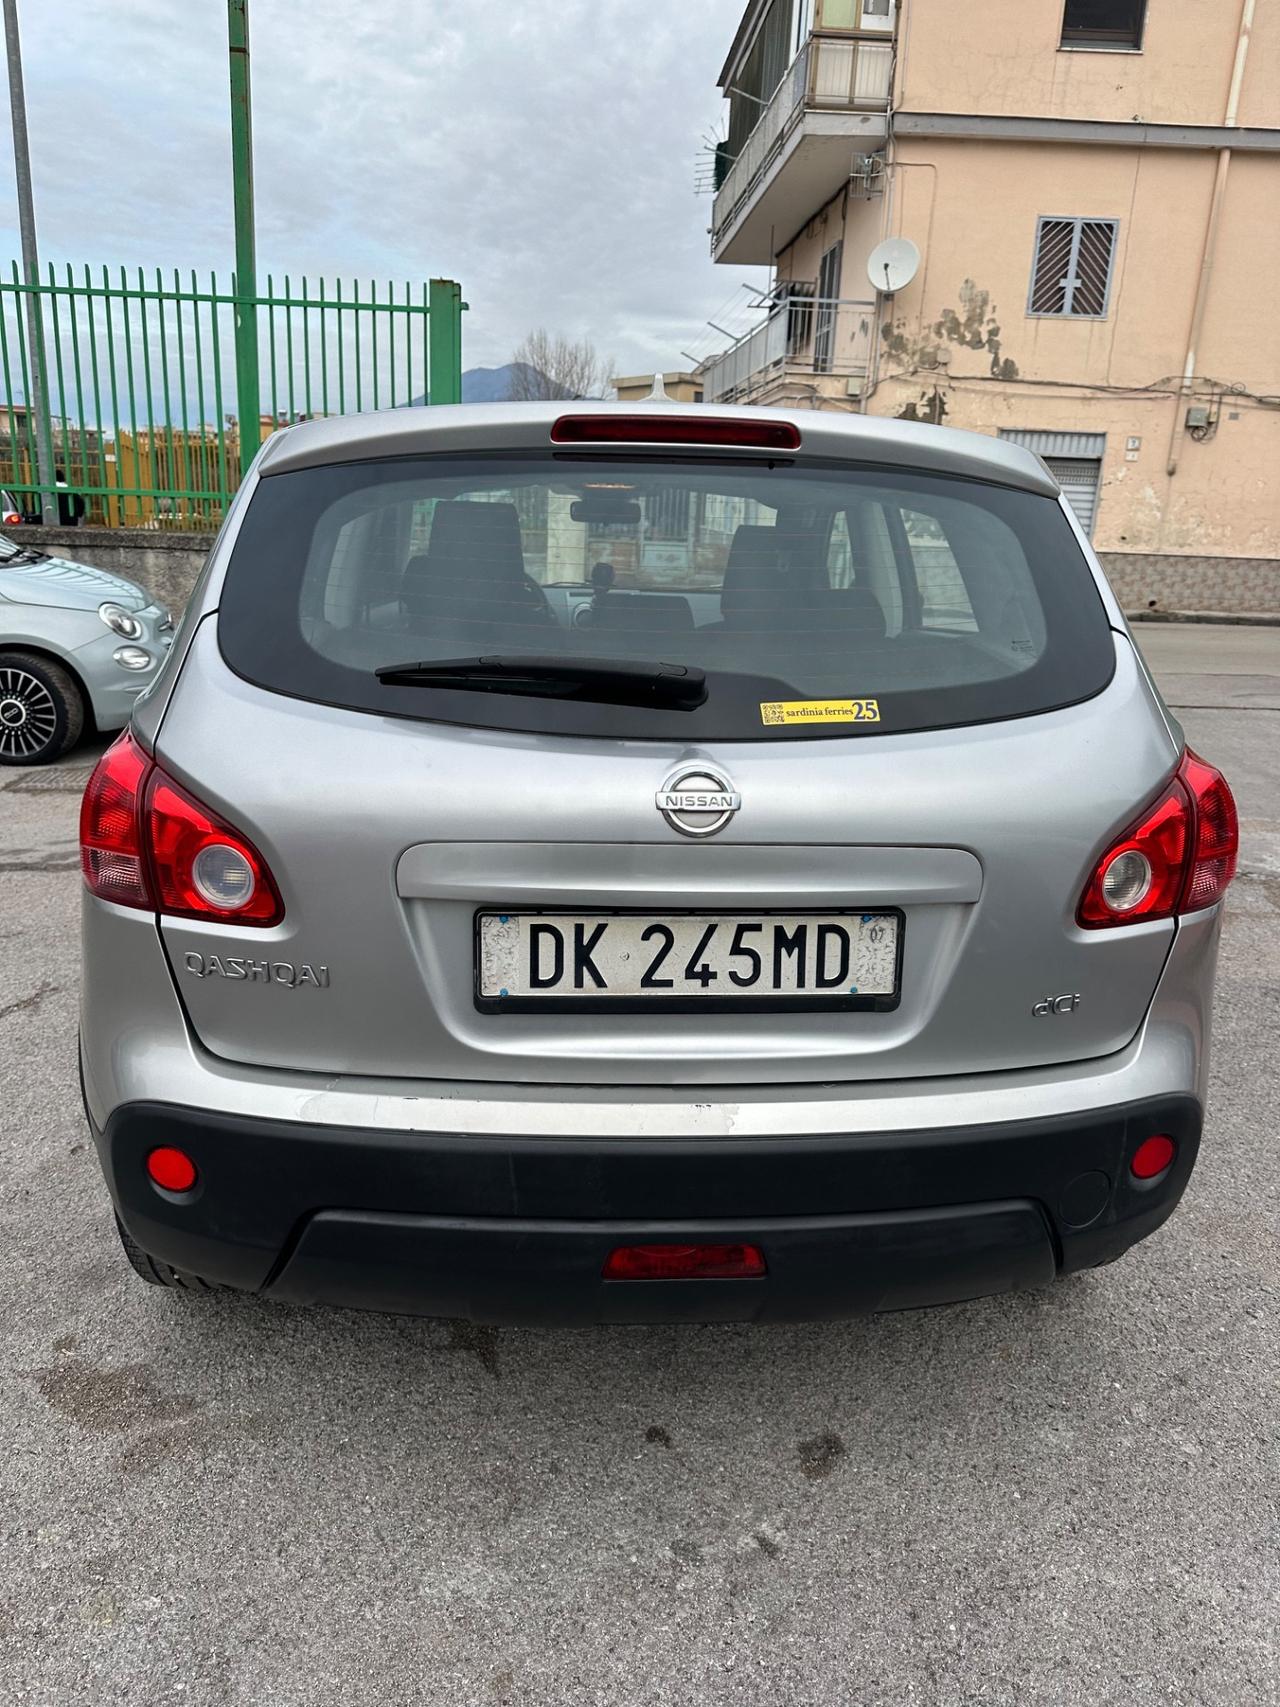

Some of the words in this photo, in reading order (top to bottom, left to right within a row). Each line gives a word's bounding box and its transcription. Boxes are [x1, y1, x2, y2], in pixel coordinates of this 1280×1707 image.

[786, 707, 823, 717] sardinia
[825, 706, 854, 716] ferries
[852, 701, 878, 720] 25
[665, 795, 733, 807] NISSAN
[529, 923, 608, 989] DK
[640, 923, 851, 989] 245MD
[184, 951, 330, 989] QASHQAI
[1032, 993, 1080, 1017] dCi
